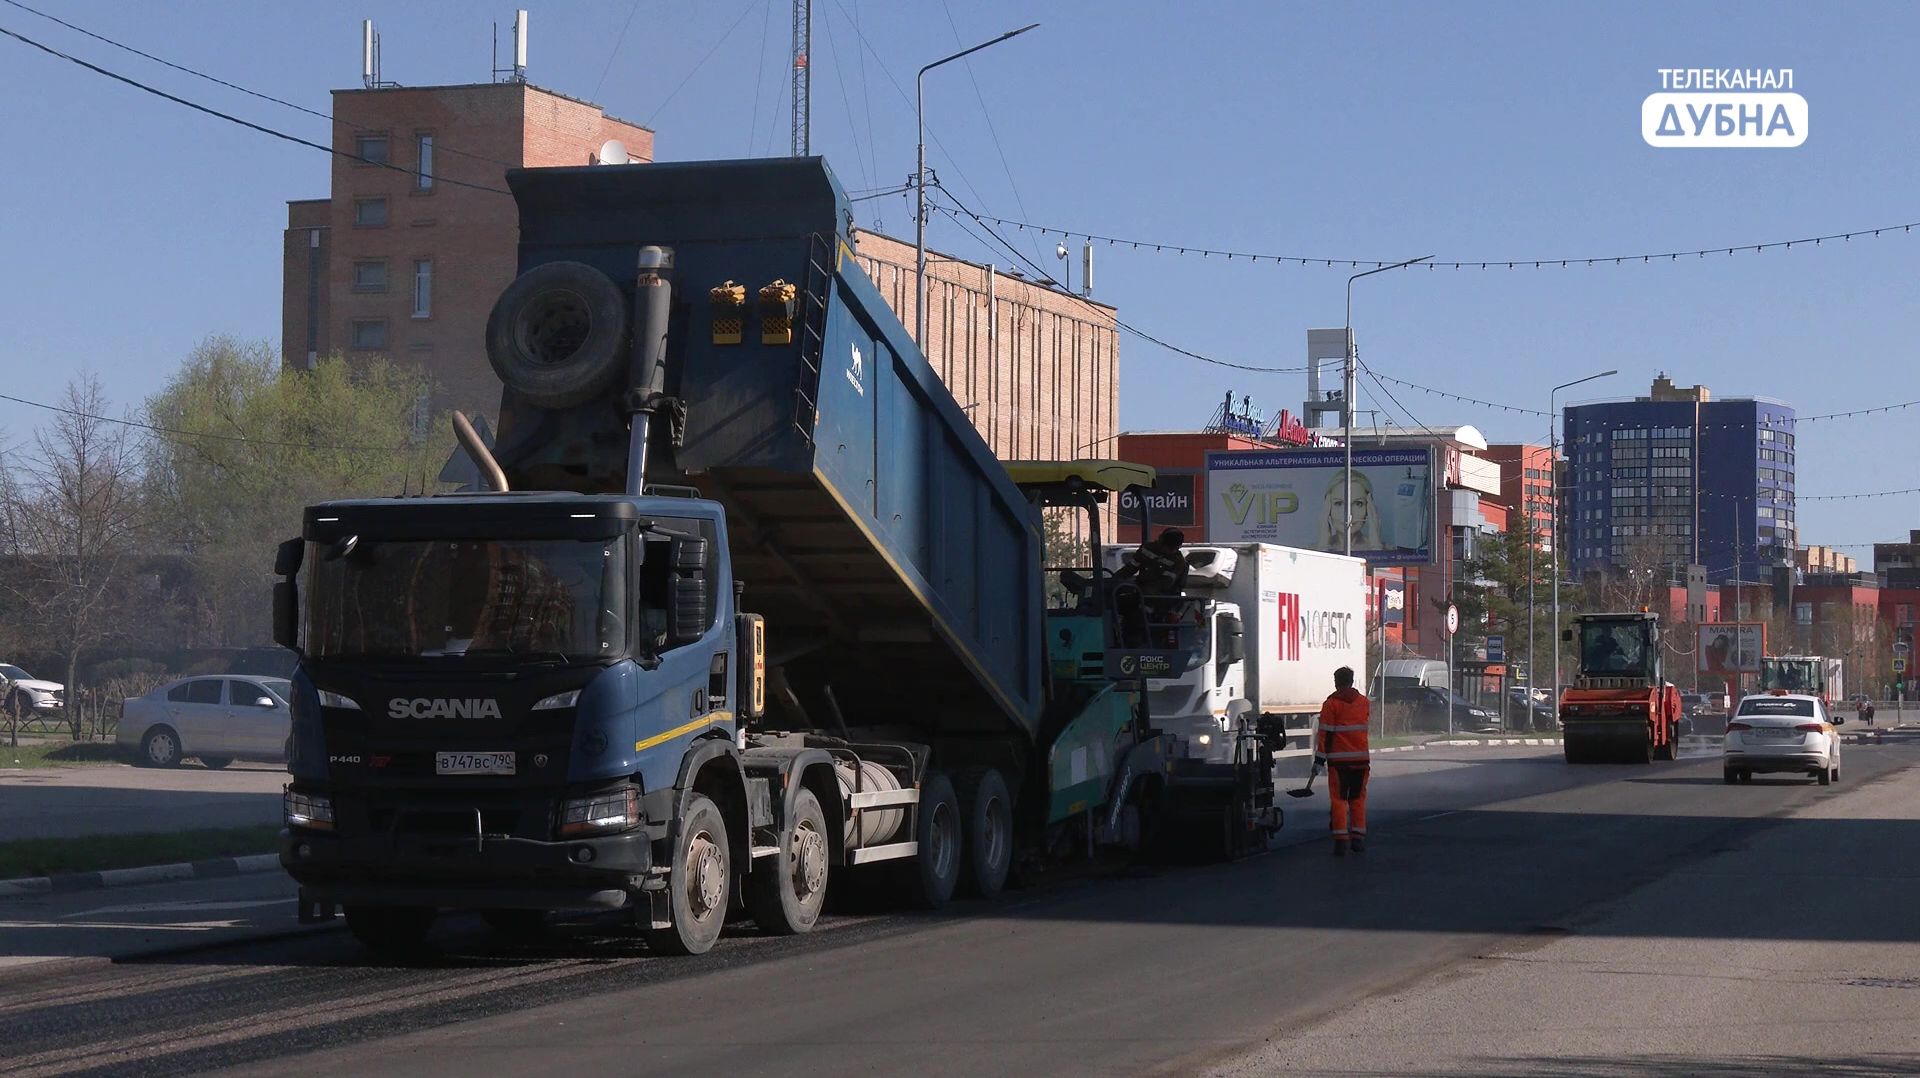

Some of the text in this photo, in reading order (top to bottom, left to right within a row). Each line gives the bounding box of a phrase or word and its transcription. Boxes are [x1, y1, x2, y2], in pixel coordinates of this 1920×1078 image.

[1214, 455, 1426, 467] УНИКАЛЬНАЯ АЛЬТЕРНАТИВА ПЛАСЧЕСКОЙ ОПЕРАЦИИ
[1121, 491, 1188, 509] билайн
[1221, 491, 1299, 525] VIP
[1279, 592, 1352, 661] FM LOGISTIC
[387, 698, 502, 719] SCANIA
